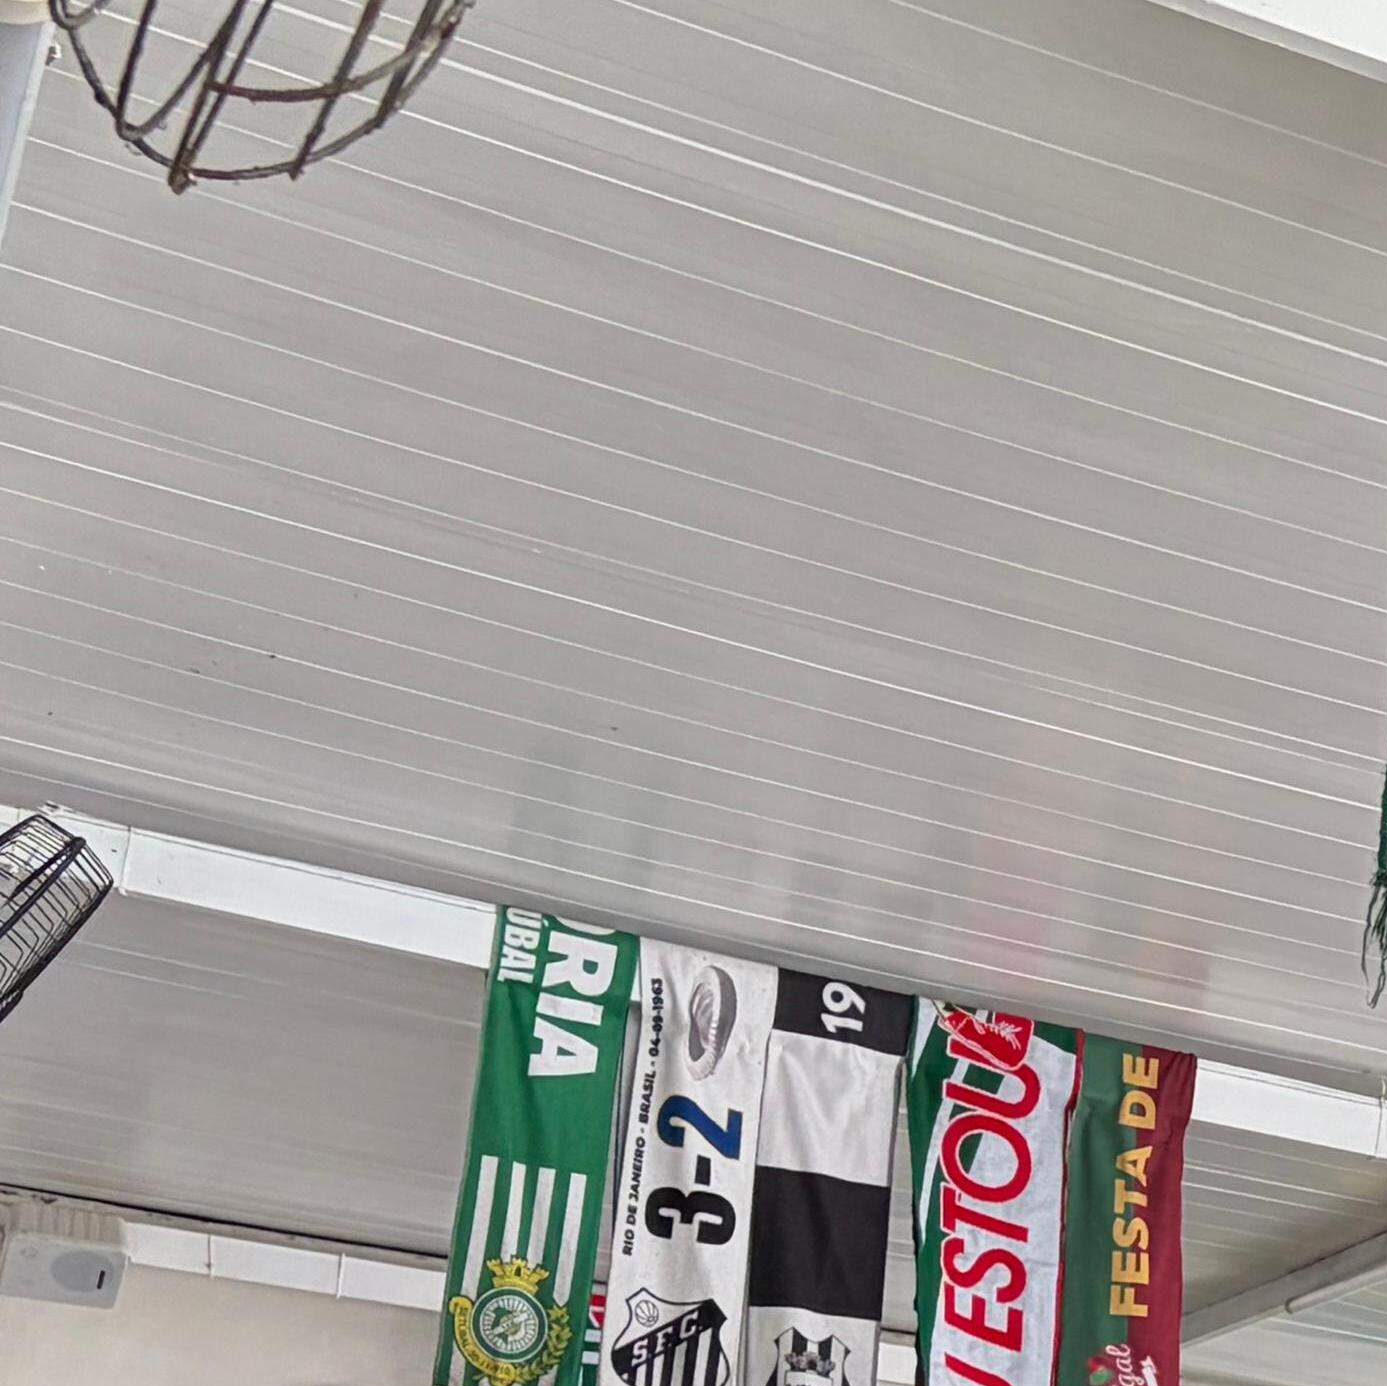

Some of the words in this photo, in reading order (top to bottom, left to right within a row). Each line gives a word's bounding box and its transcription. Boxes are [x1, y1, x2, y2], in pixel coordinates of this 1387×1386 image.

[527, 915, 619, 1077] RIA
[820, 981, 866, 1033] 19
[638, 1071, 657, 1125] BRASIL
[1119, 1053, 1160, 1130] DE
[629, 1137, 647, 1199] JANEIRO
[645, 1095, 740, 1245] 3-2
[622, 1225, 638, 1257] RIO
[627, 1200, 641, 1222] DE
[1110, 1146, 1153, 1318] FESTA
